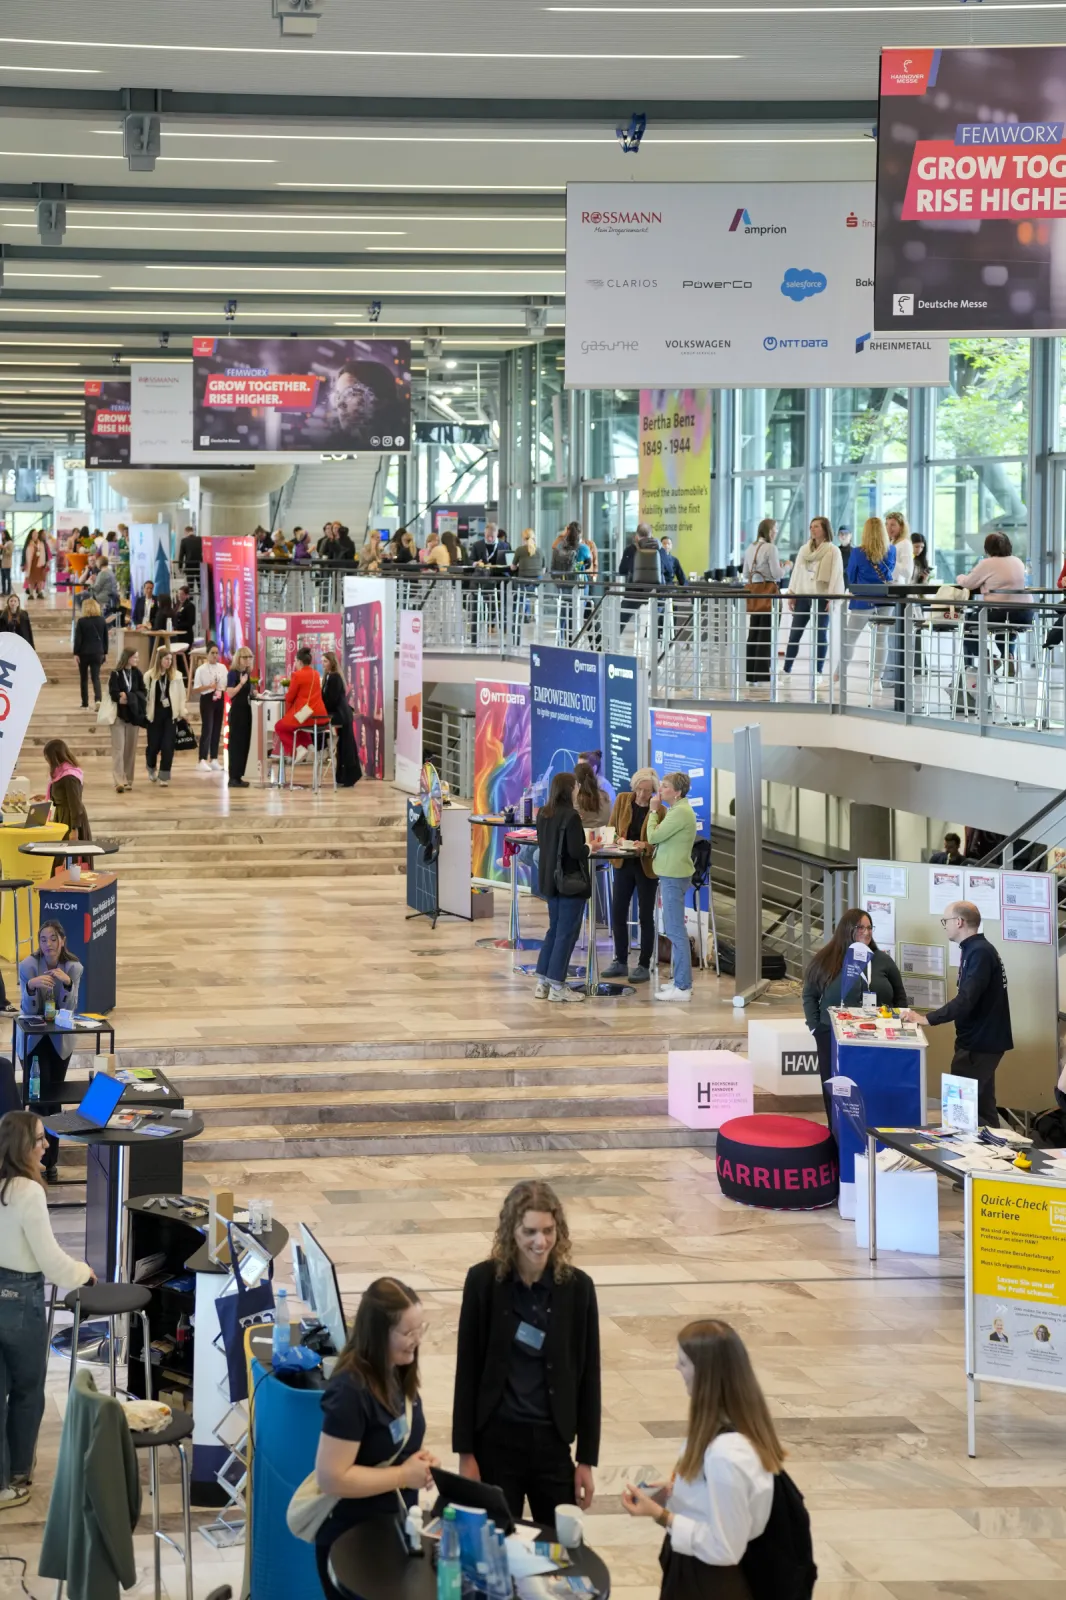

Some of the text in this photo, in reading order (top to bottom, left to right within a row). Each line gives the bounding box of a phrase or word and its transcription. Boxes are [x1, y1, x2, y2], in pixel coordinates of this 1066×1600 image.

[962, 125, 1058, 144] FEMWORX
[917, 154, 1066, 181] GROW TOG
[916, 187, 1066, 213] RISE HIGHE
[581, 211, 662, 224] ROSSMANN
[744, 224, 787, 236] amprion
[607, 279, 658, 288] CLARIOS
[682, 280, 753, 289] PowerCo
[786, 279, 823, 290] salesforce
[918, 299, 988, 309] Deutsche Messe
[665, 339, 731, 349] VOLKSWAGEN
[779, 339, 800, 348] NTT
[869, 342, 931, 350] RHEINMETALL
[226, 368, 268, 377] FEMWORX
[208, 380, 311, 392] GROW TOGETHER.
[208, 393, 283, 405] RISE HIGHER.
[97, 413, 127, 423] GROW
[643, 413, 696, 431] Bertha Benz
[97, 424, 117, 433] RISE
[642, 440, 663, 456] 1849
[669, 437, 691, 453] 1944
[642, 485, 708, 498] Proved the automobile's
[641, 502, 700, 517] viability with the first
[678, 520, 693, 532] drive
[491, 691, 506, 703] NTT
[533, 685, 597, 713] EMPOWERING YOU
[44, 902, 78, 911] ALSTOM
[784, 1054, 819, 1072] HAW
[980, 1193, 1049, 1211] Quick-Check
[980, 1207, 1020, 1221] Karriere
